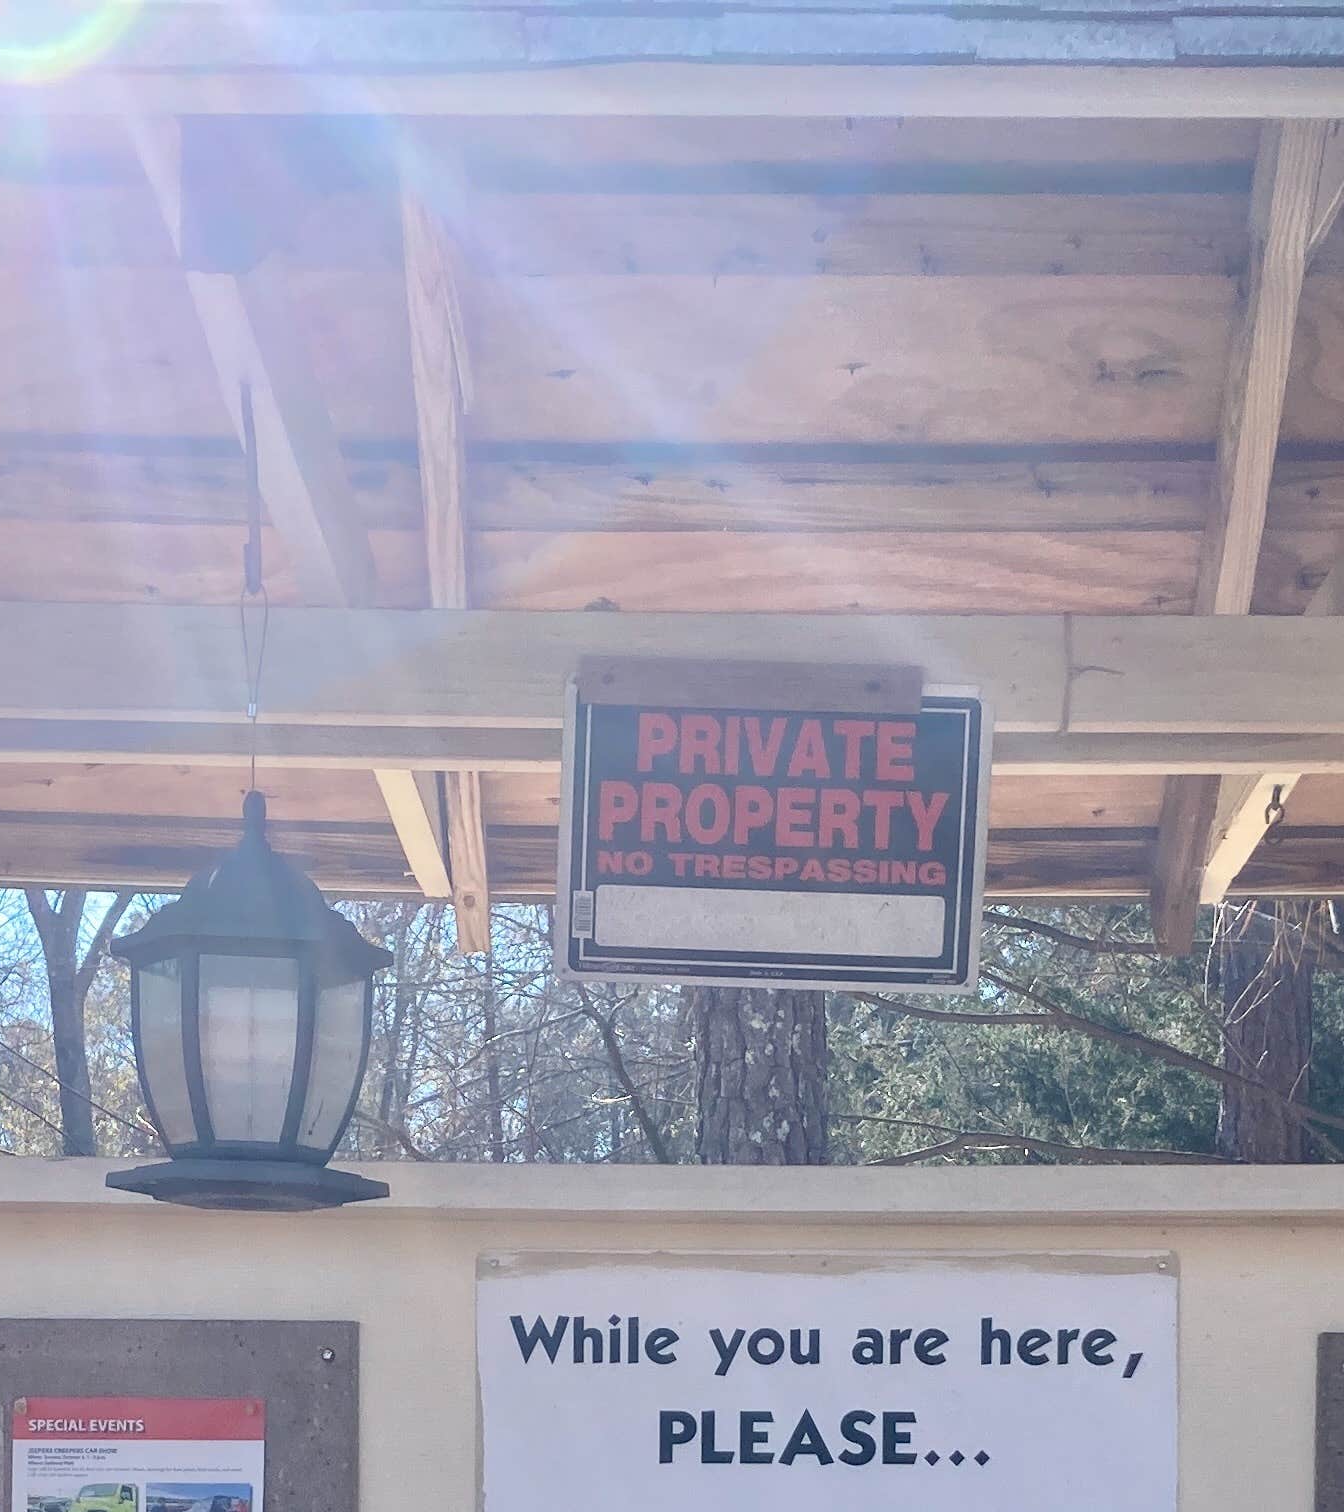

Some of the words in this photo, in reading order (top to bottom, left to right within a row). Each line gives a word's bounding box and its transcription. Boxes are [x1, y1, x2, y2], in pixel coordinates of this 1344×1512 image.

[636, 713, 916, 781] PRIVATE
[598, 780, 951, 851] PROPERTY
[597, 850, 653, 876] NO
[668, 852, 947, 885] TRESPASSING
[510, 1315, 679, 1364] While
[710, 1328, 820, 1376] you
[852, 1329, 949, 1365] are
[981, 1318, 1143, 1378] here,
[28, 1419, 86, 1432] SPECIAL
[90, 1419, 144, 1433] EVENTS
[659, 1408, 990, 1466] PLEASE...
